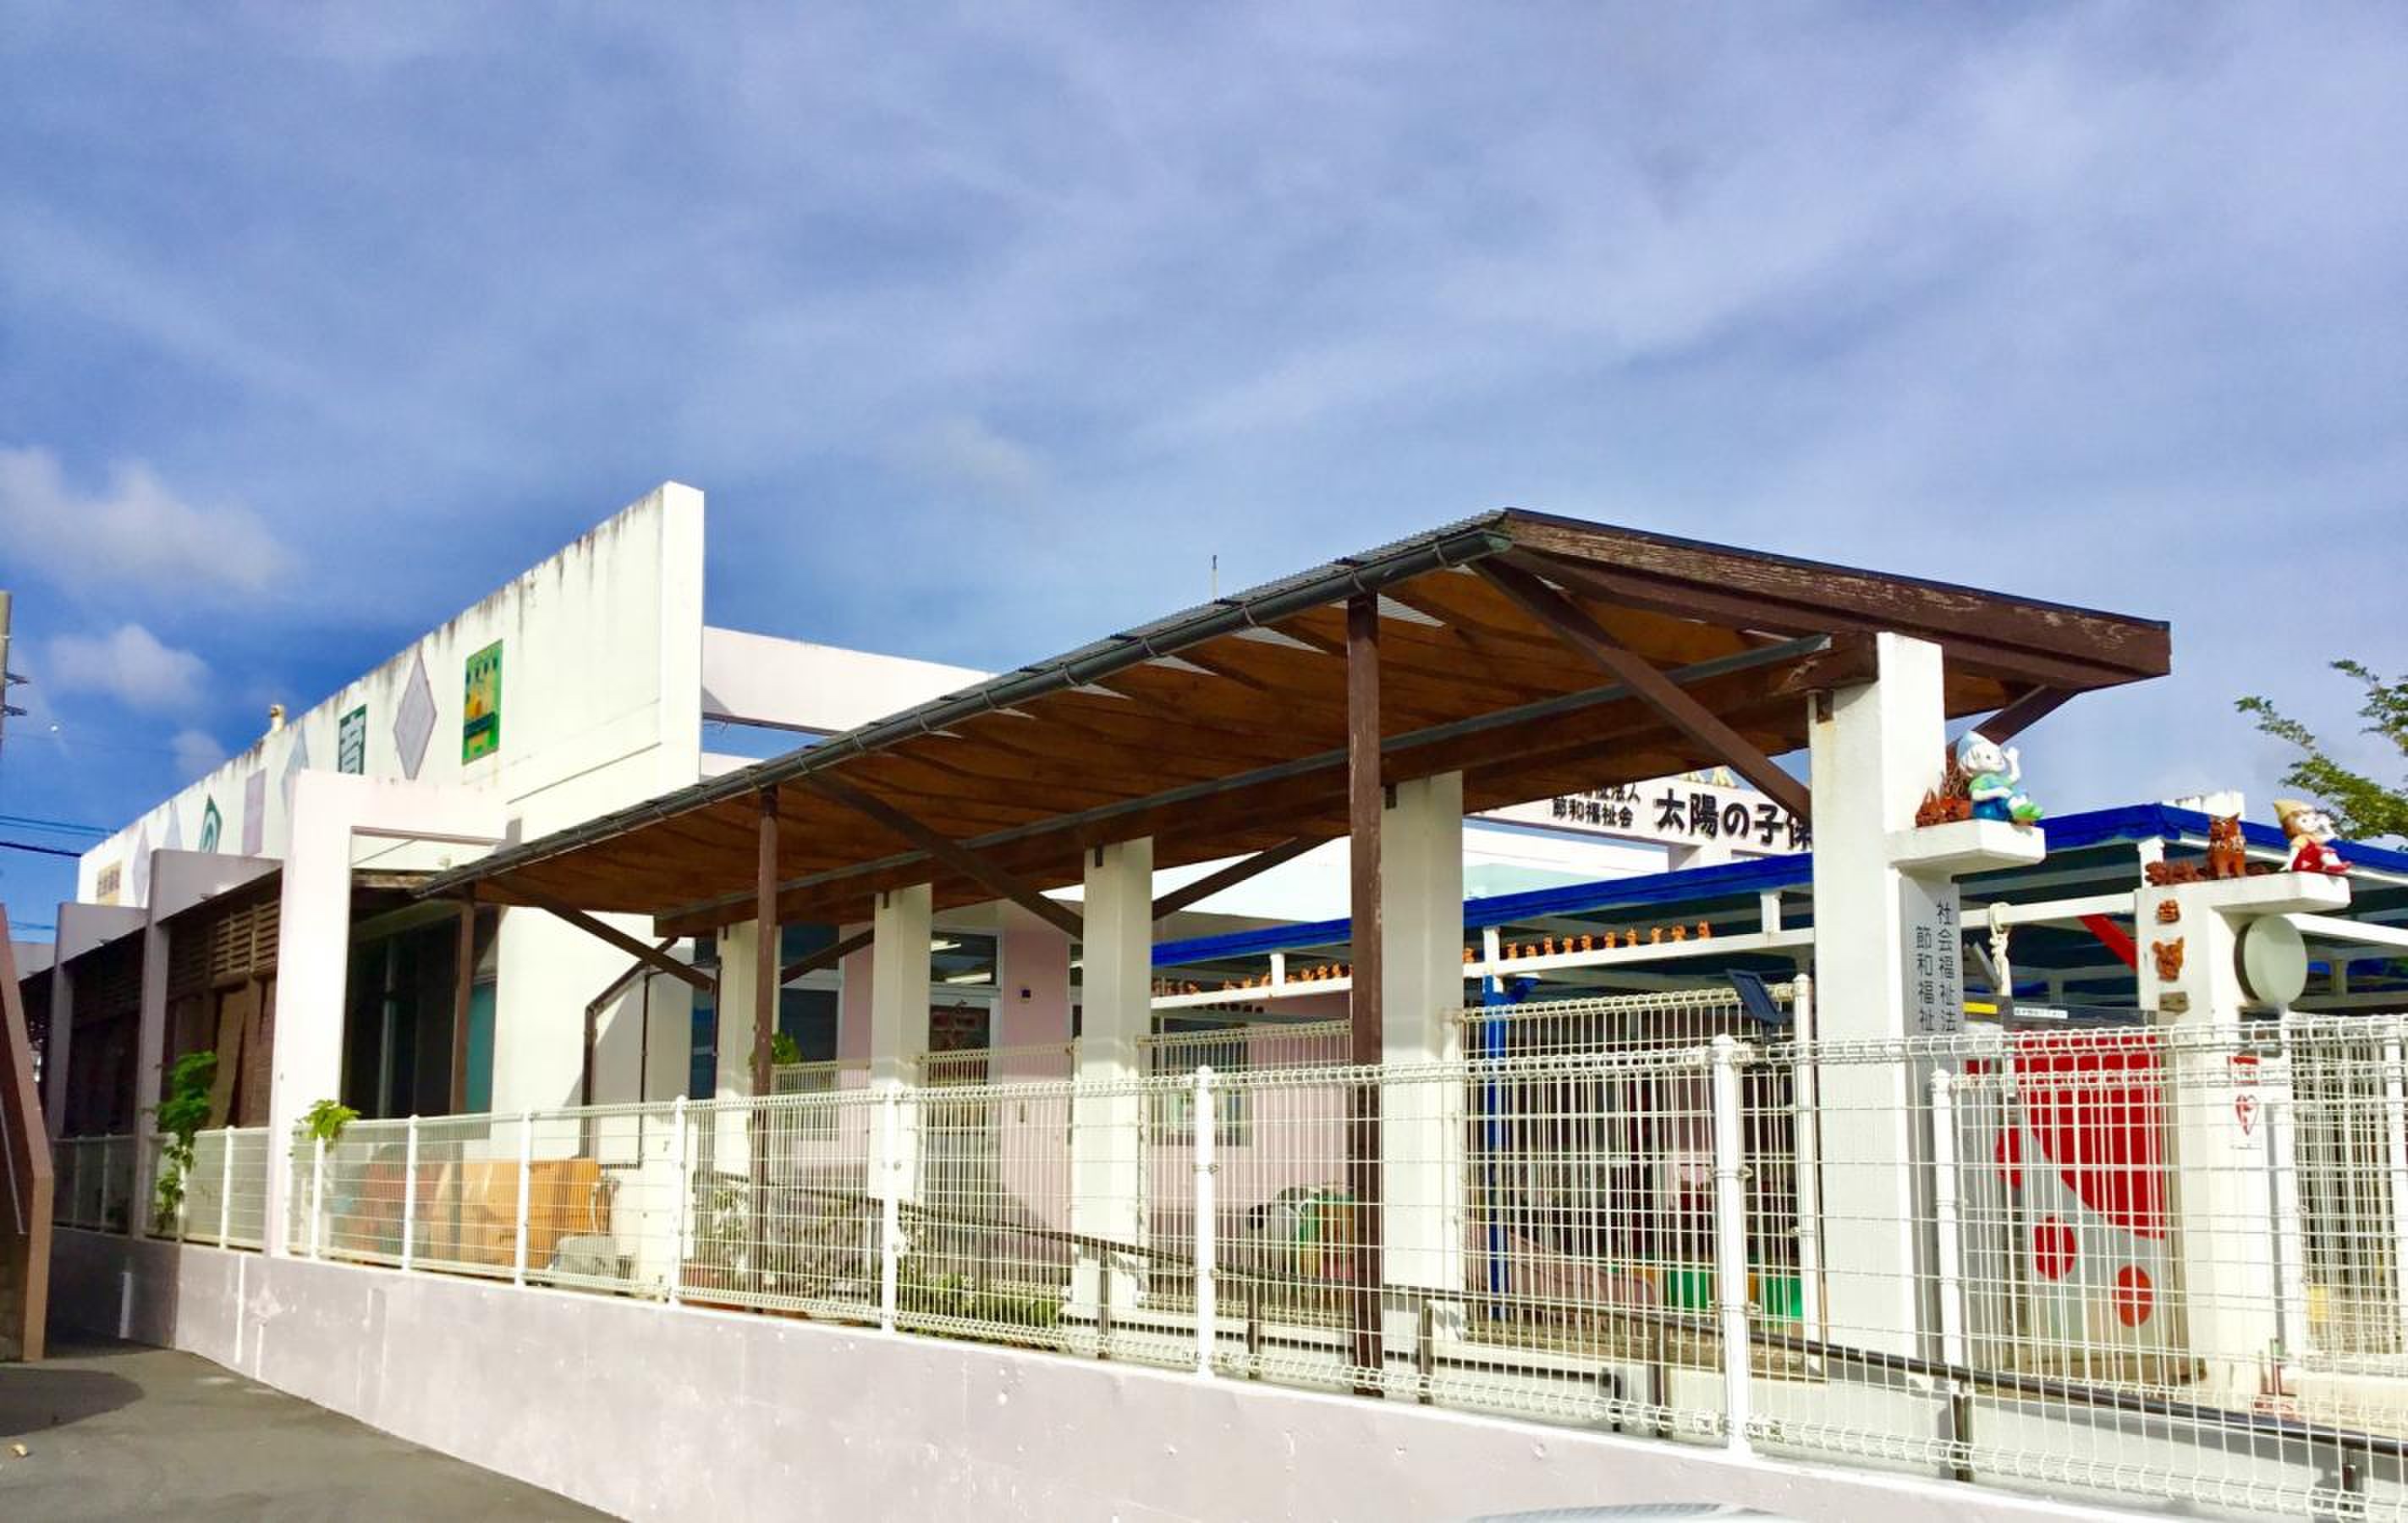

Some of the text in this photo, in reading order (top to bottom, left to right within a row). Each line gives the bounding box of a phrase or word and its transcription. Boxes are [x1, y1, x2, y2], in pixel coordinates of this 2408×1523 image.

[1916, 926, 1936, 1052] 節和福祉
[1937, 900, 1957, 1052] 社会福祉法
